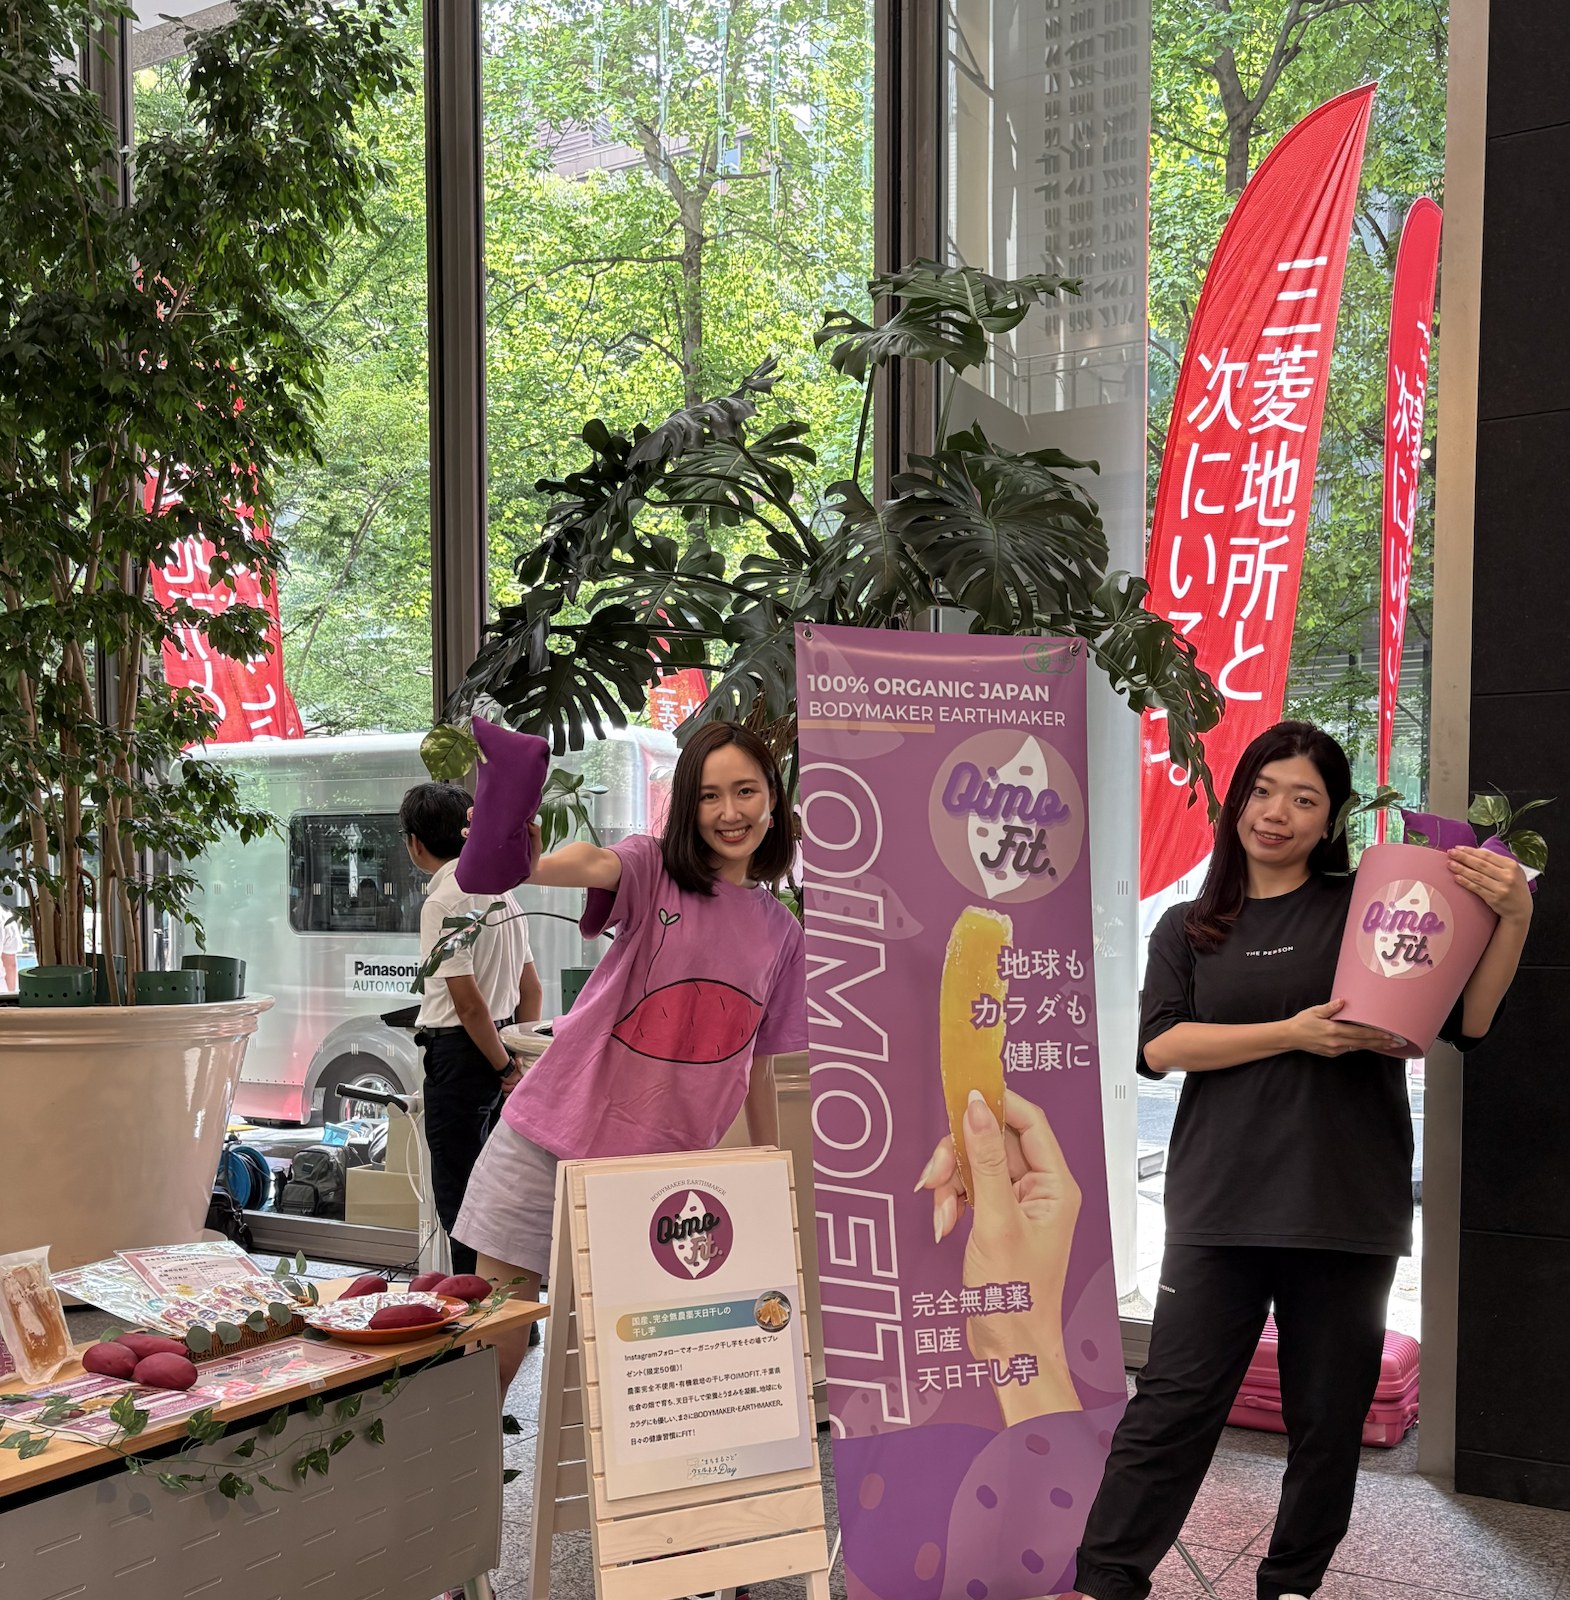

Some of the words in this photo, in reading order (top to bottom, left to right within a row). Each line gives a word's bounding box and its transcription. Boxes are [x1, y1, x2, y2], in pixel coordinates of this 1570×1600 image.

[1218, 256, 1328, 701] 三菱地所と
[807, 674, 869, 694] 100%
[874, 677, 974, 699] ORGANIC
[979, 682, 1050, 702] JAPAN
[809, 701, 933, 721] BODYMAKER
[939, 706, 1066, 727] EARTHMAKER
[1001, 948, 1084, 980] 地球も
[1262, 945, 1294, 957] PERSON
[352, 980, 413, 993] AUTOMOT
[975, 994, 1086, 1026] カラダも
[1003, 1039, 1091, 1073] 健康に
[911, 1284, 1029, 1318] 完全無農薬
[633, 1326, 657, 1338] 干し芋
[914, 1326, 963, 1355] 国産
[917, 1356, 1036, 1393] 天日干し芋
